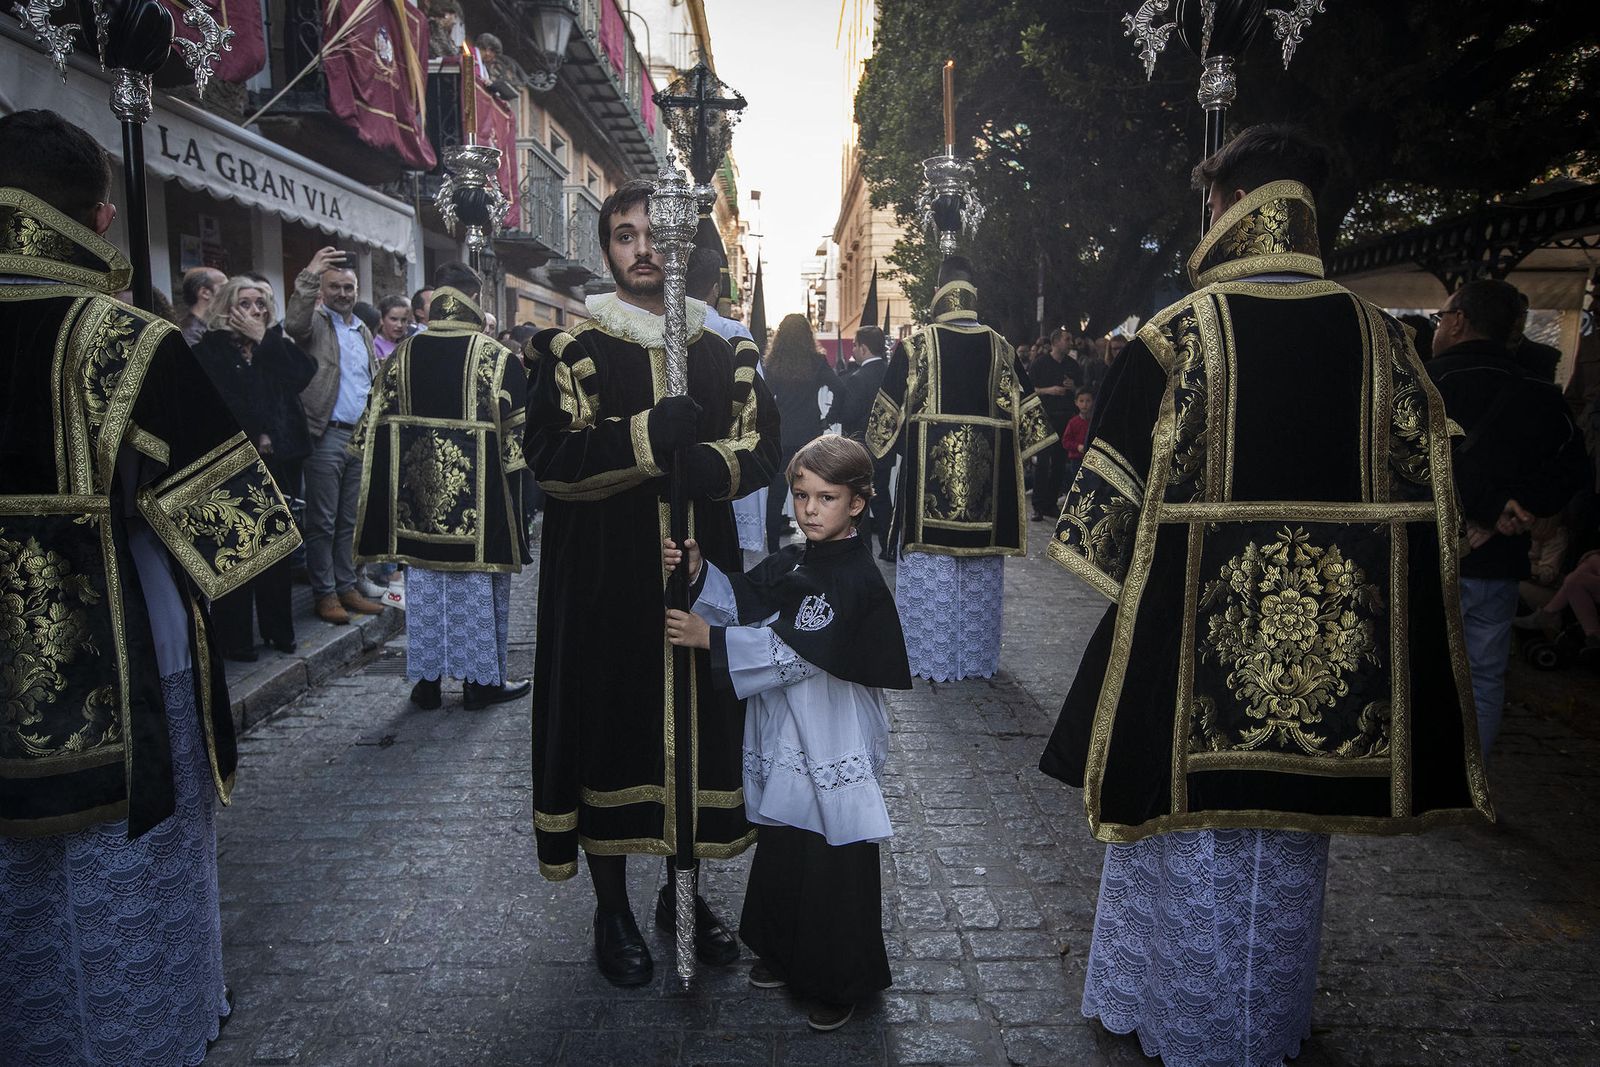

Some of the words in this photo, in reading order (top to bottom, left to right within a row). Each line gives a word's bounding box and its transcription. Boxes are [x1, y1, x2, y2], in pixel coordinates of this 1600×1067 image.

[158, 124, 206, 172] LA
[215, 152, 296, 204] GRAN
[302, 184, 344, 221] VIA
